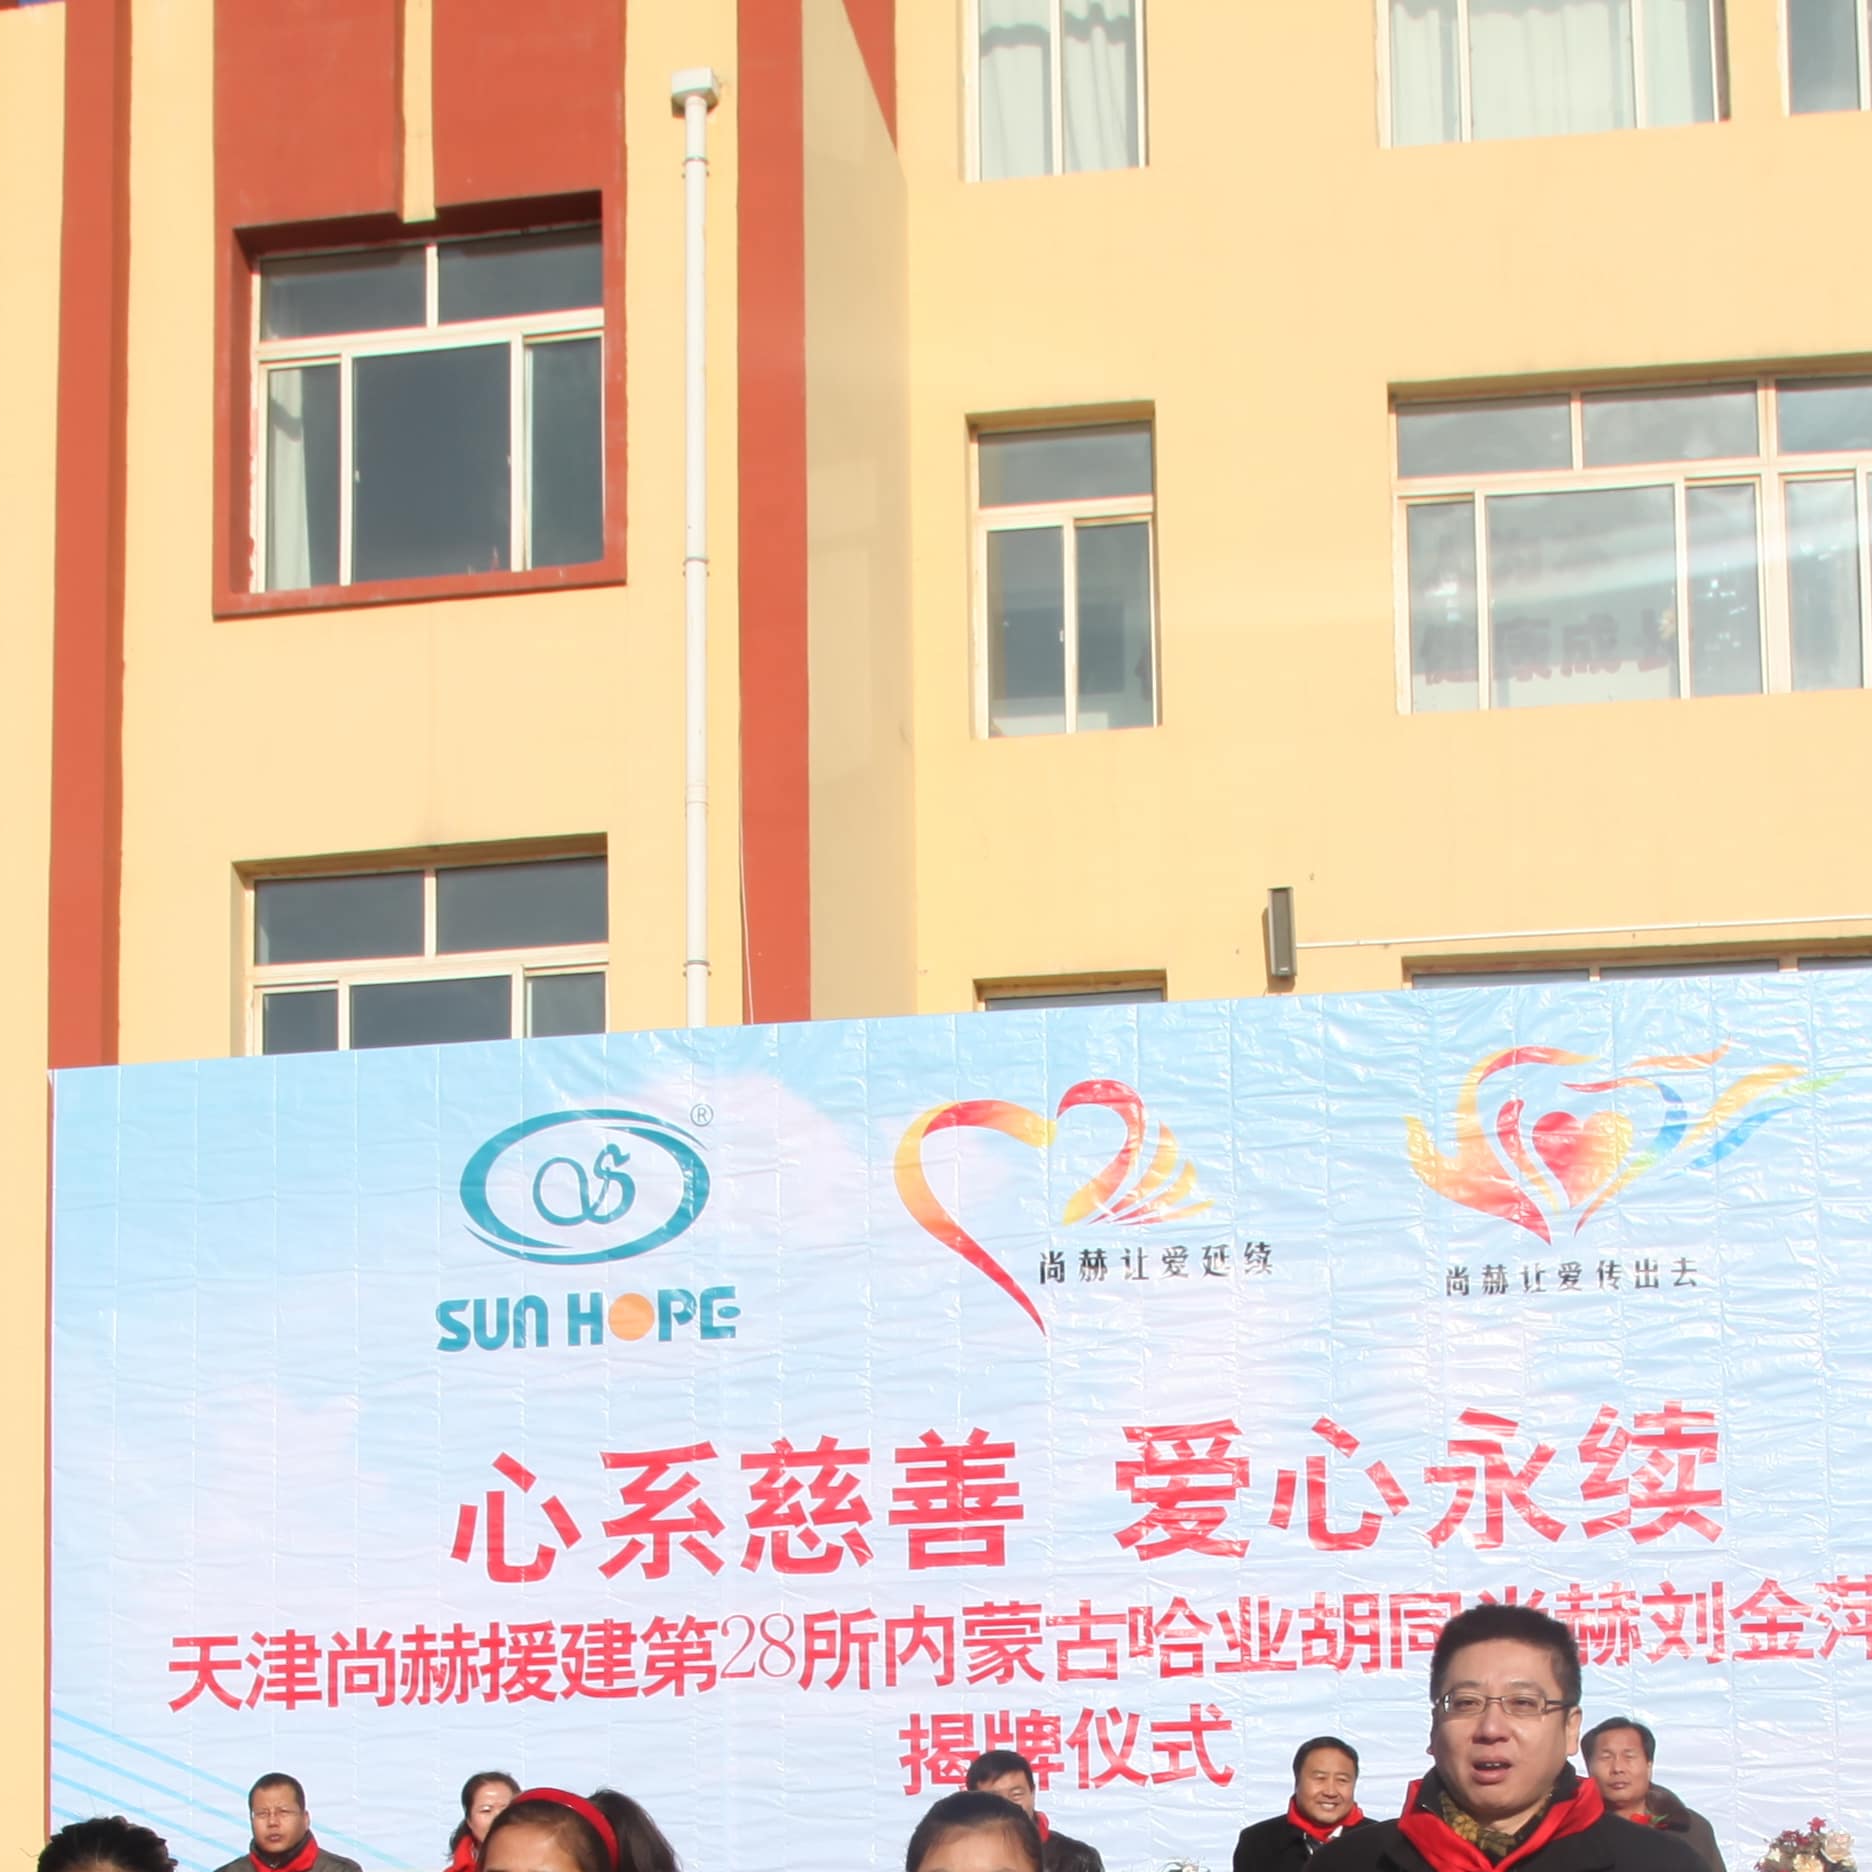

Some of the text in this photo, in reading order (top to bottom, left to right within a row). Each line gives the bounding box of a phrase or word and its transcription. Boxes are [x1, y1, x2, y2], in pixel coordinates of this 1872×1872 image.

[1038, 1241, 1274, 1285] 尚赫让爱延续
[1444, 1258, 1700, 1298] 尚赫让爱传出去
[567, 1285, 741, 1347] HOPE
[449, 1399, 1724, 1586] 心系慈善 爱心永续
